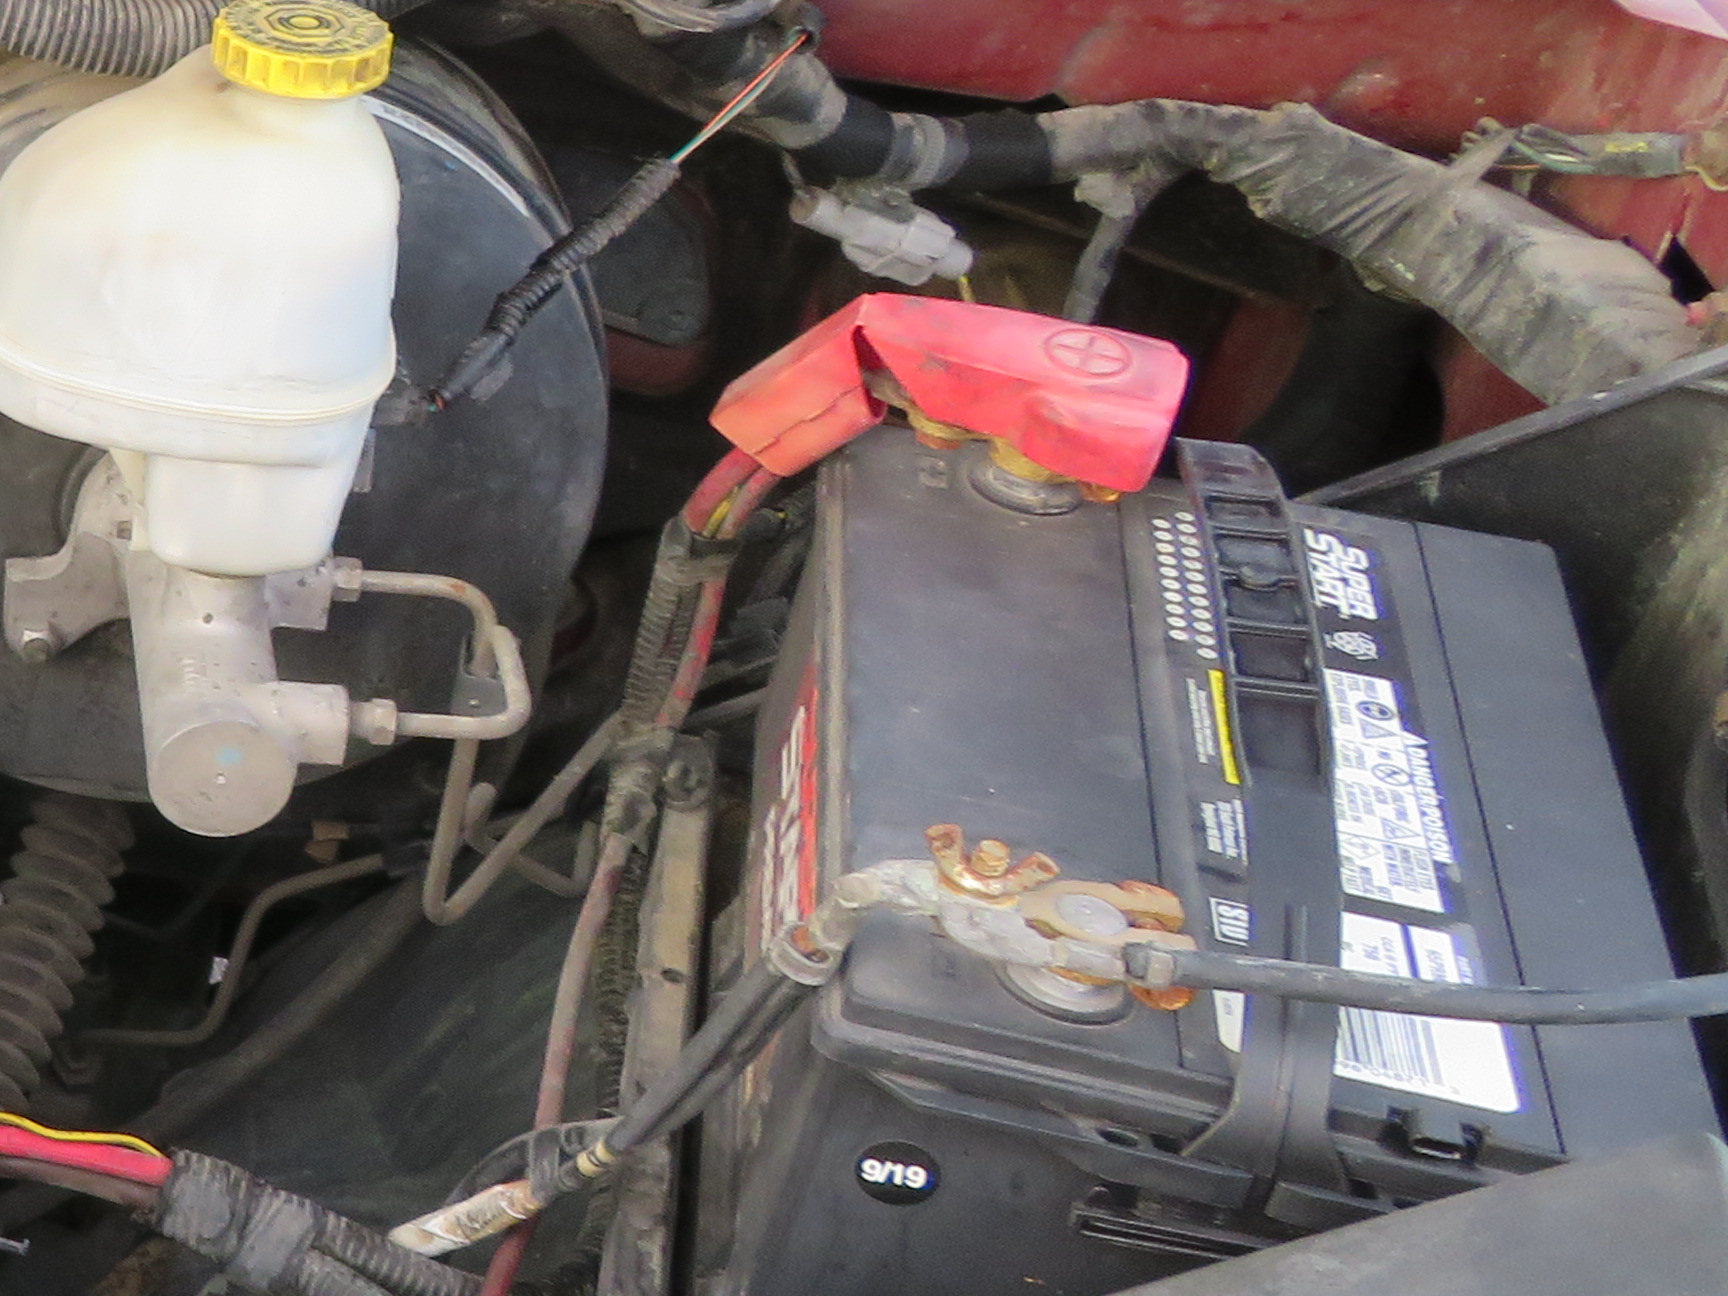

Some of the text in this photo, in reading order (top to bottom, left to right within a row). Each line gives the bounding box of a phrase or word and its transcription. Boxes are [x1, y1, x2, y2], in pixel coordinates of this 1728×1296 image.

[1303, 527, 1351, 621] START
[1343, 546, 1379, 621] SUPER
[861, 1157, 929, 1190] 9/19
